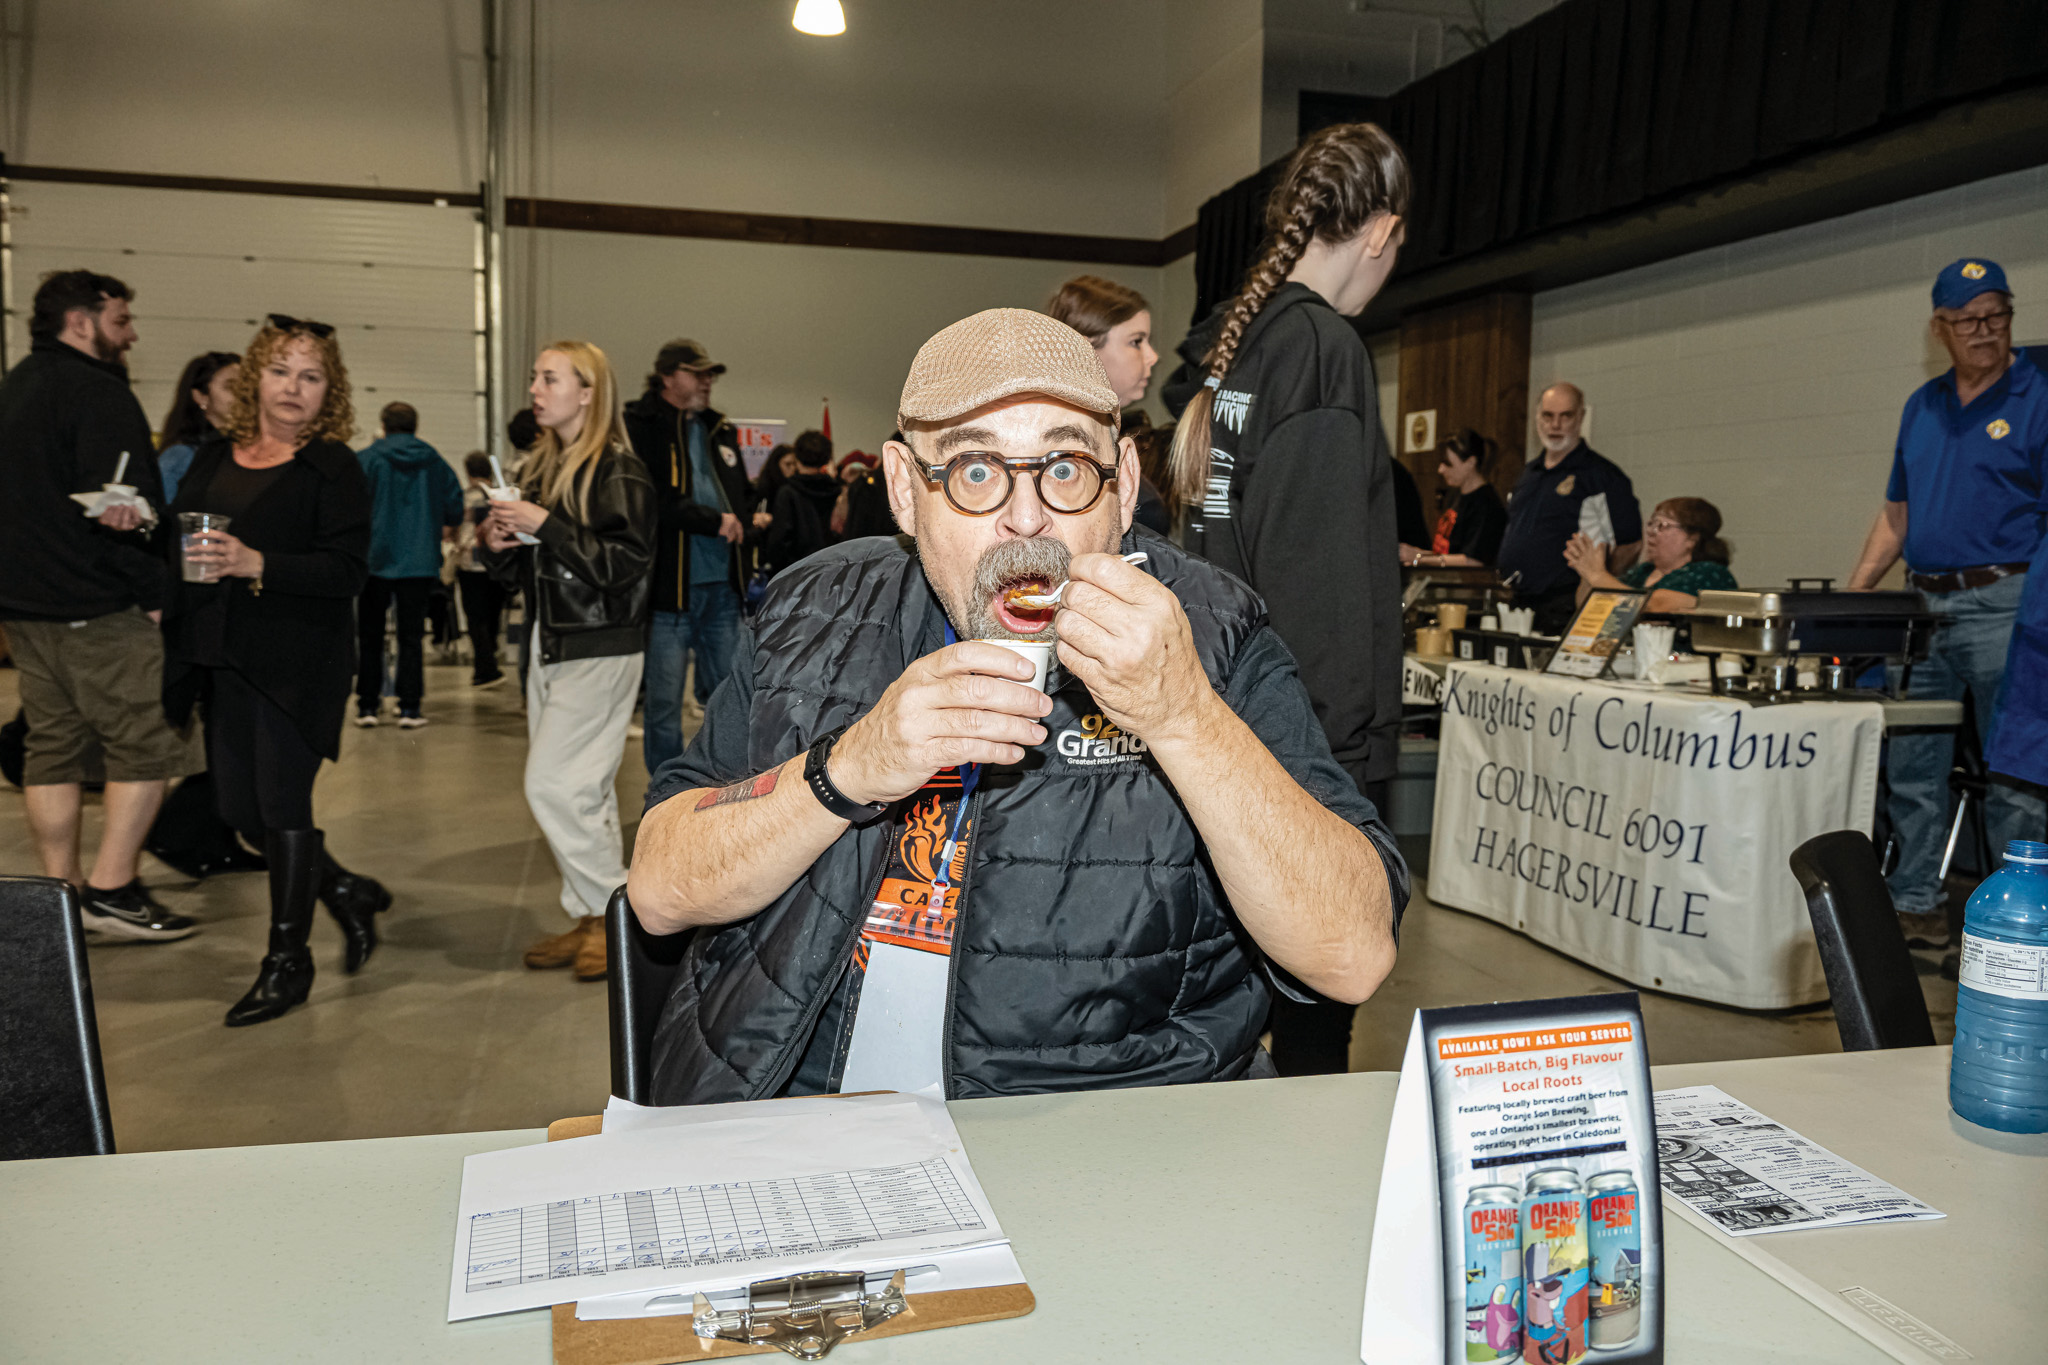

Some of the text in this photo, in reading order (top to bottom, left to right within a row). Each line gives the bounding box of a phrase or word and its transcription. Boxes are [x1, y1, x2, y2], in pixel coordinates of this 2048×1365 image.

[1414, 675, 1444, 704] WING
[1442, 669, 1817, 771] Knights of Columbus
[1477, 762, 1709, 866] COUNCIL 6091
[1471, 826, 1710, 939] HAGERSVILLE
[1442, 1027, 1629, 1054] AVAILABLE NOW! ASK YOUR SERVER
[1455, 1051, 1624, 1078] Small-Batch, Big Flavour
[1503, 1075, 1583, 1093] Local Roots
[1458, 1089, 1628, 1114] Featuring locally brewed craft beer from
[1502, 1105, 1589, 1122] Oranje Son Brewing,
[1471, 1130, 1487, 1138] one
[1489, 1128, 1499, 1136] of
[1500, 1124, 1540, 1134] Ontario's
[1542, 1119, 1577, 1129] smallest
[1474, 1127, 1621, 1152] operating right here in Caledonia!
[1530, 1201, 1581, 1230] ORANJE
[1591, 1195, 1636, 1221] ORANJE
[1605, 1211, 1632, 1229] SON
[1471, 1208, 1519, 1234] ORANJE
[1485, 1223, 1515, 1242] SON
[1545, 1219, 1576, 1239] SON
[662, 1262, 691, 1270] Sheet
[693, 1257, 733, 1267] Judging
